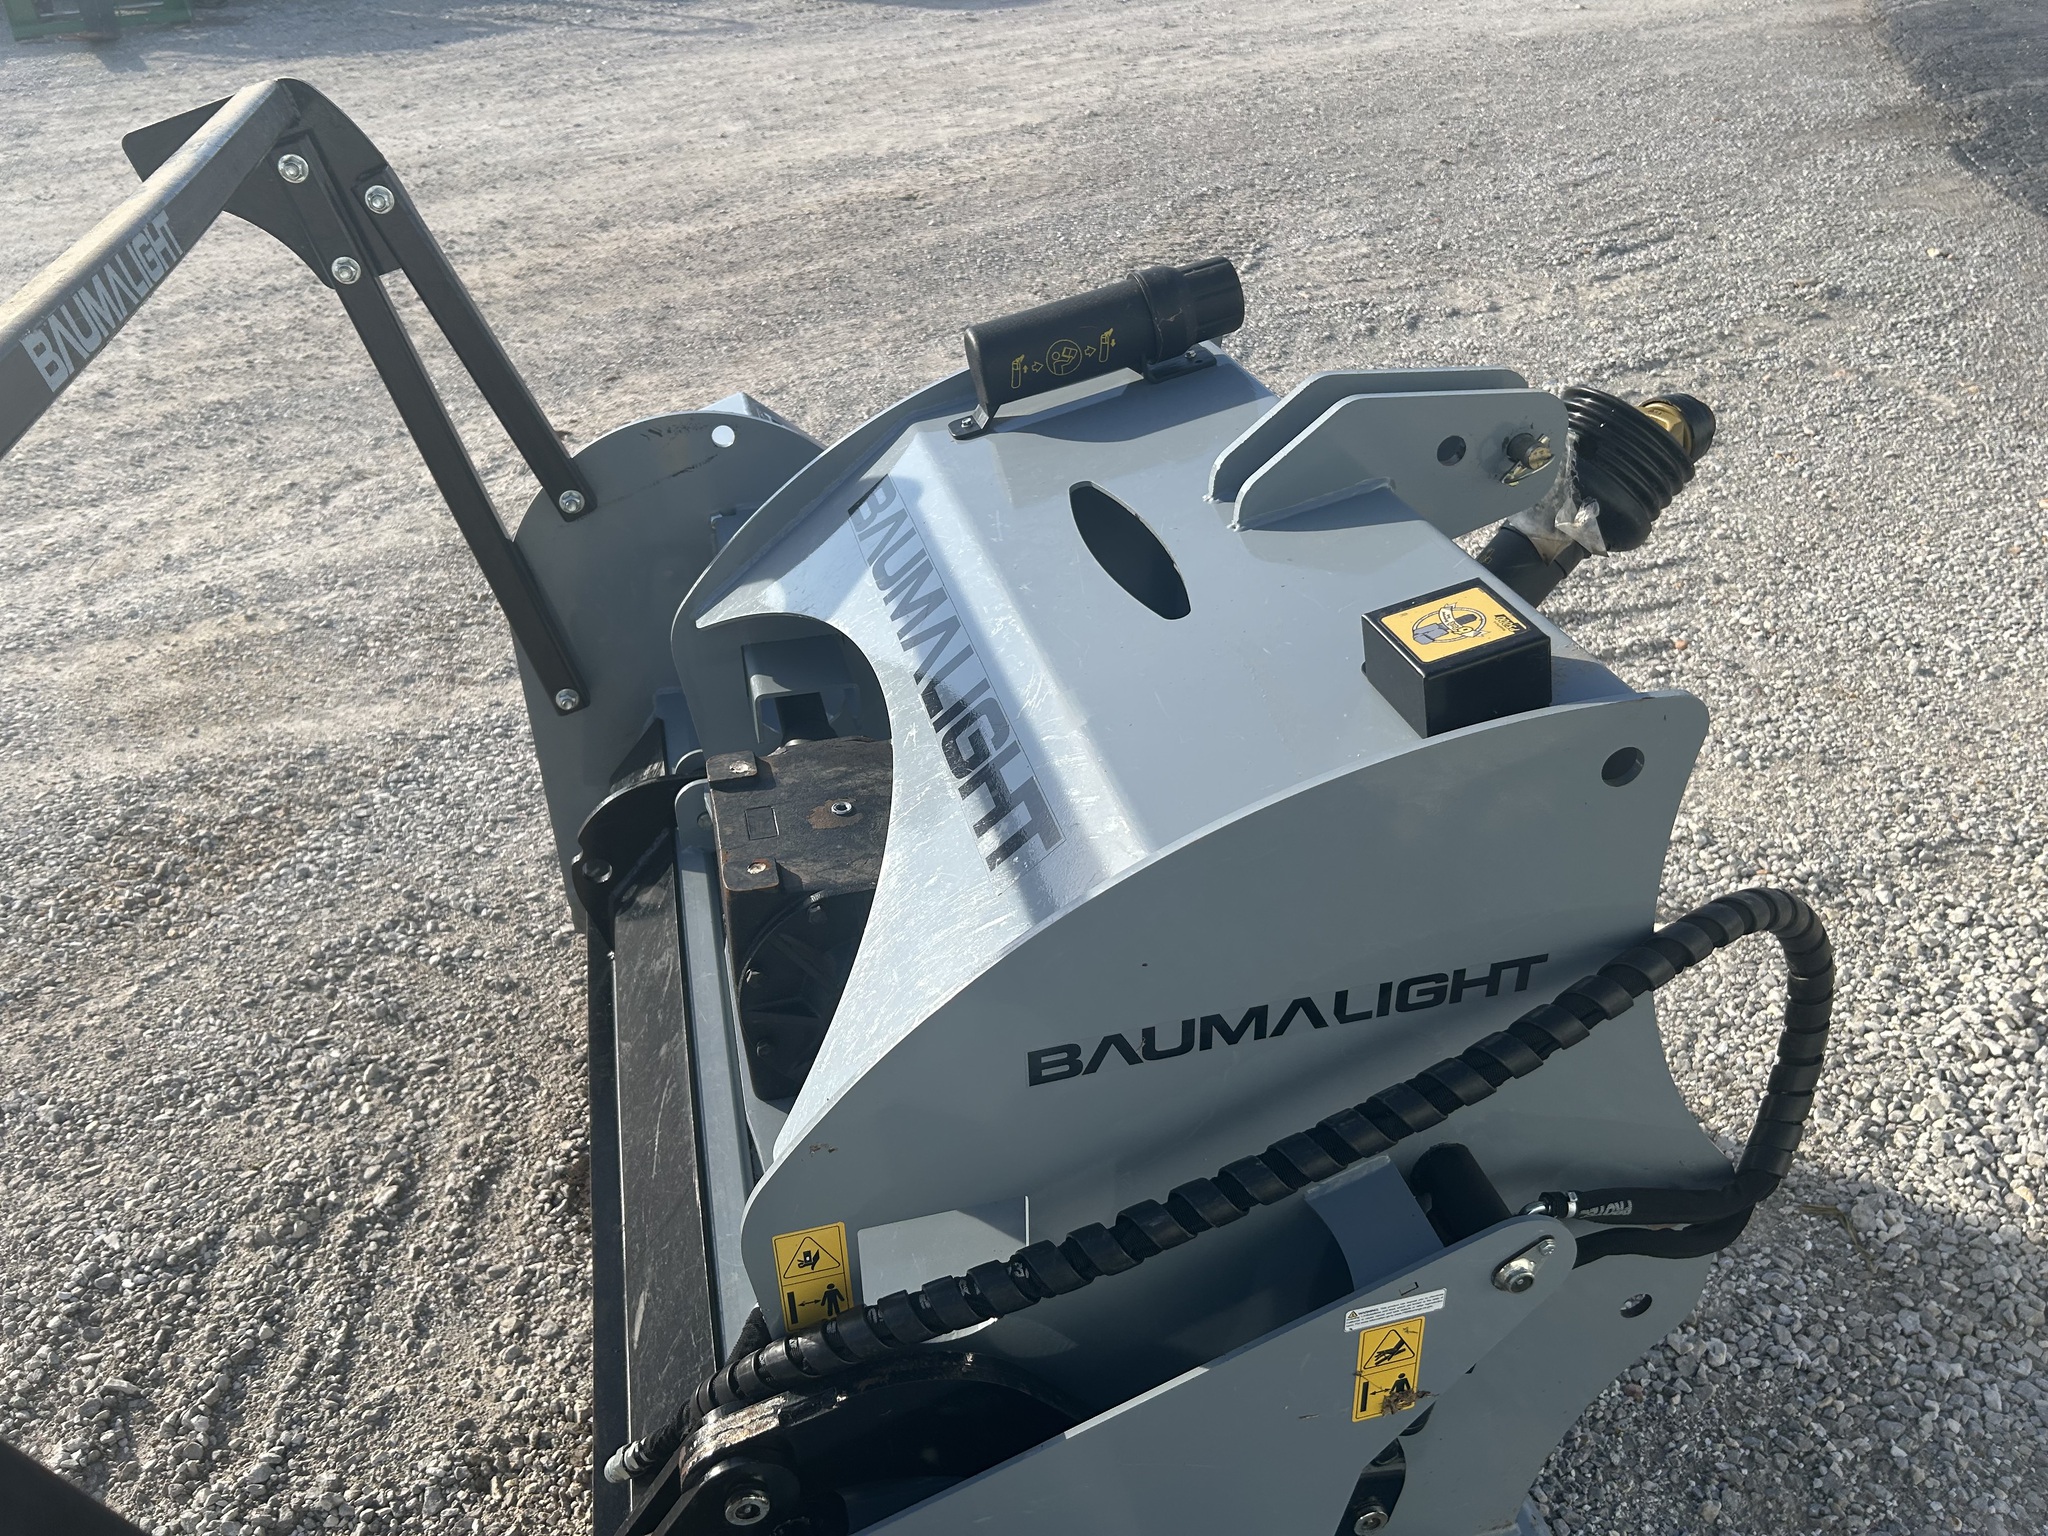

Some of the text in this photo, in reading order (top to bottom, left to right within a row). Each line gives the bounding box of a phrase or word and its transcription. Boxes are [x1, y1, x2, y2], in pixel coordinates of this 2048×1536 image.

[19, 210, 183, 393] BAUMALIGHT
[849, 474, 1066, 873] BAUMALIGHT
[1027, 953, 1549, 1087] BAUMALIGHT
